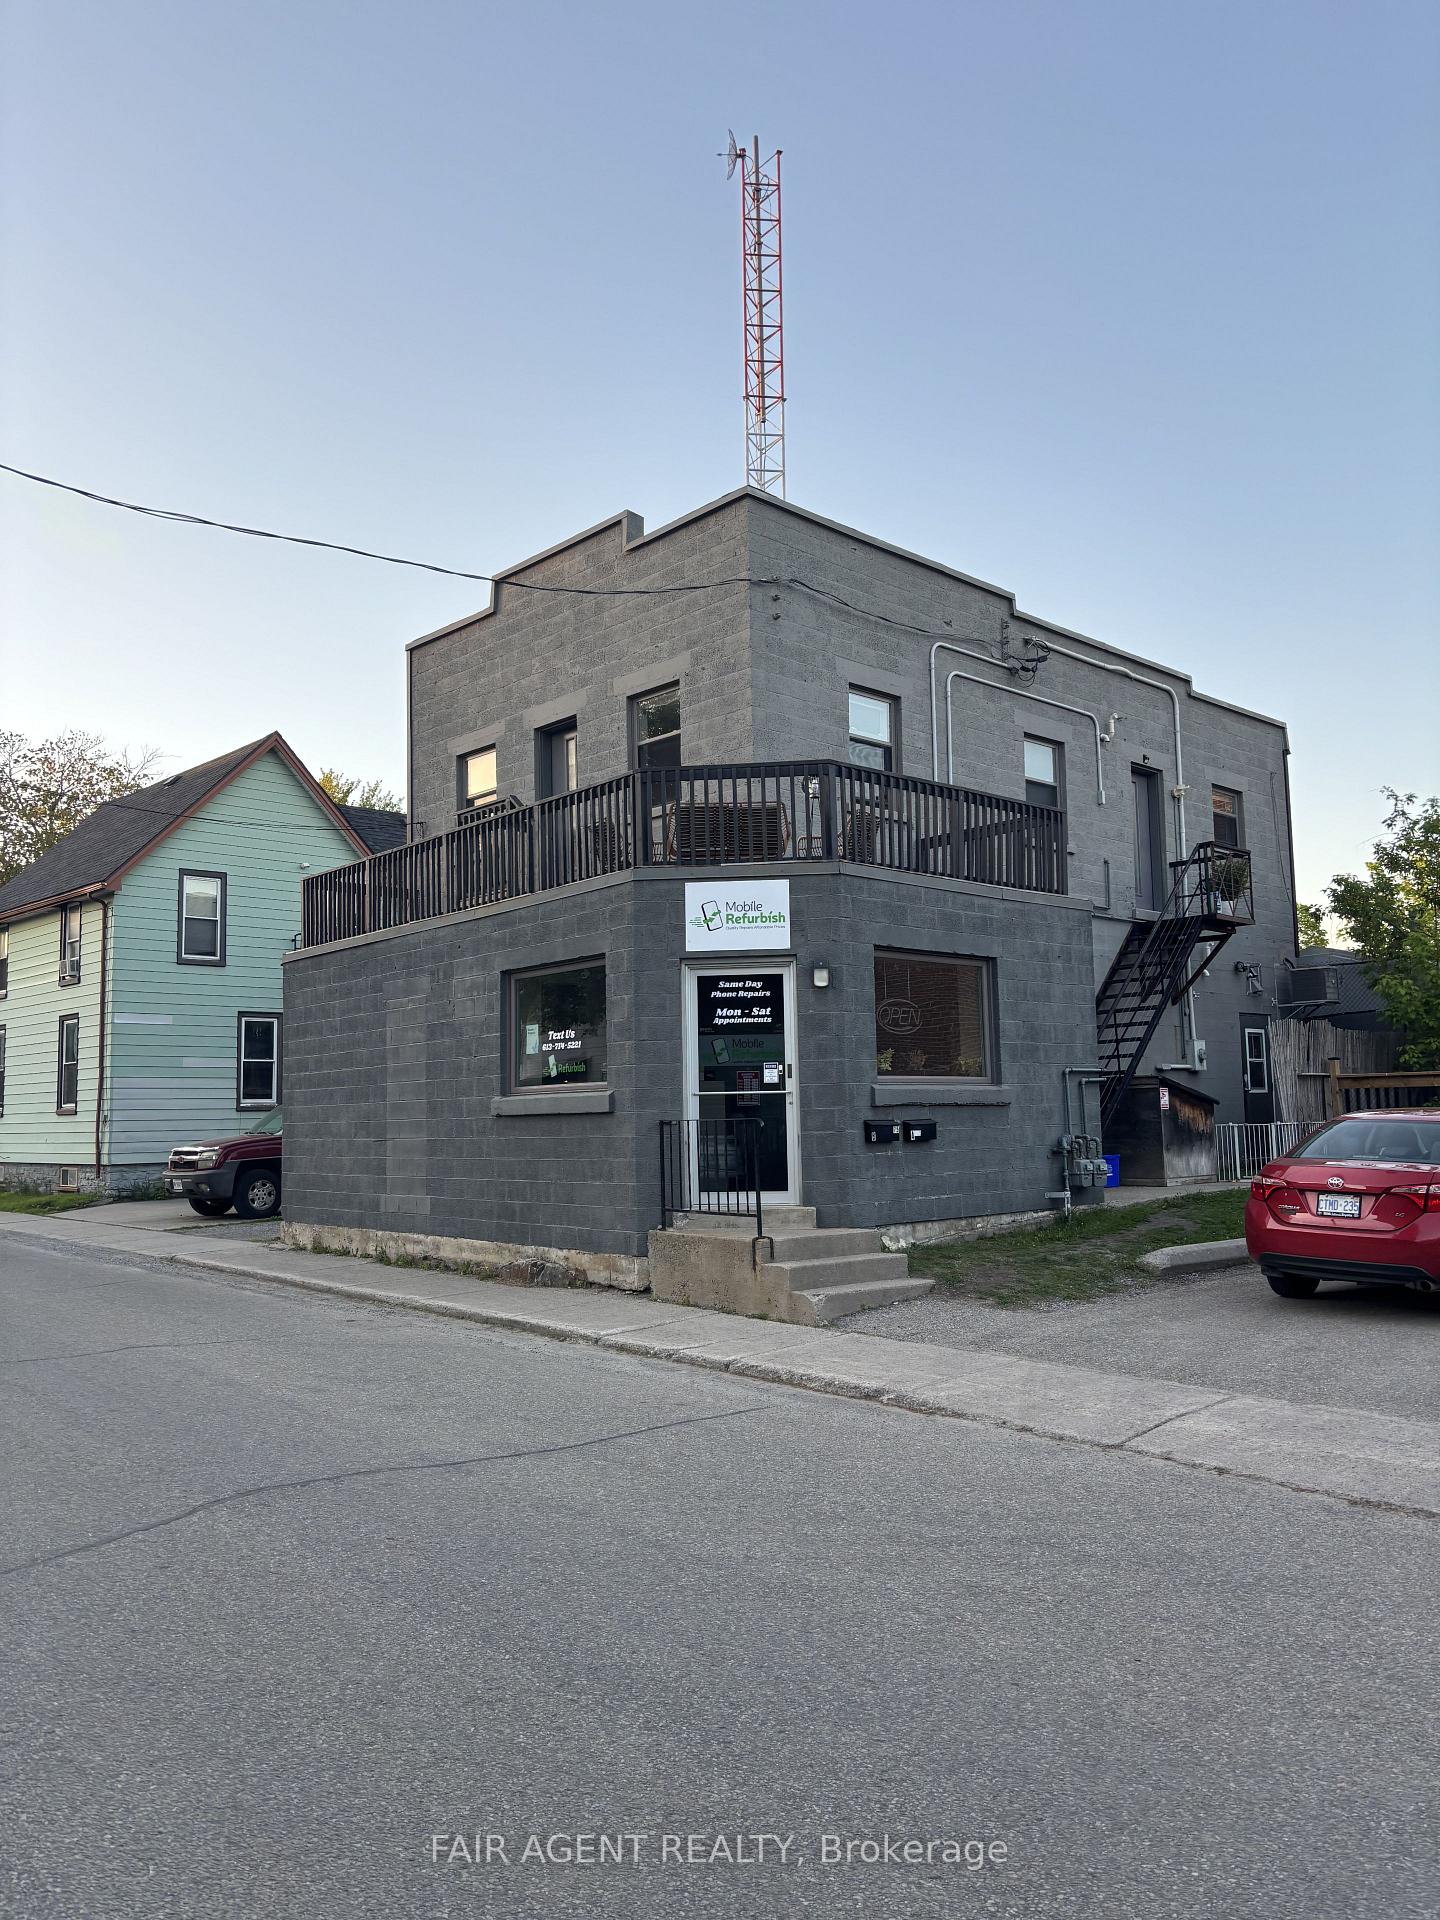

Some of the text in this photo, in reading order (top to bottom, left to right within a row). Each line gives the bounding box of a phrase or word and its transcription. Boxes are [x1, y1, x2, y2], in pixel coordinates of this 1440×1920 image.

[726, 901, 763, 912] Mobile
[726, 911, 786, 925] Refurbish
[718, 980, 763, 989] Same Day
[710, 989, 771, 998] Phone Repairs
[716, 1007, 742, 1017] Mon
[751, 1006, 772, 1016] Sat
[880, 1006, 920, 1025] OPEN
[713, 1016, 773, 1026] Appointments
[548, 1030, 565, 1041] Text
[732, 1038, 765, 1049] Mobile
